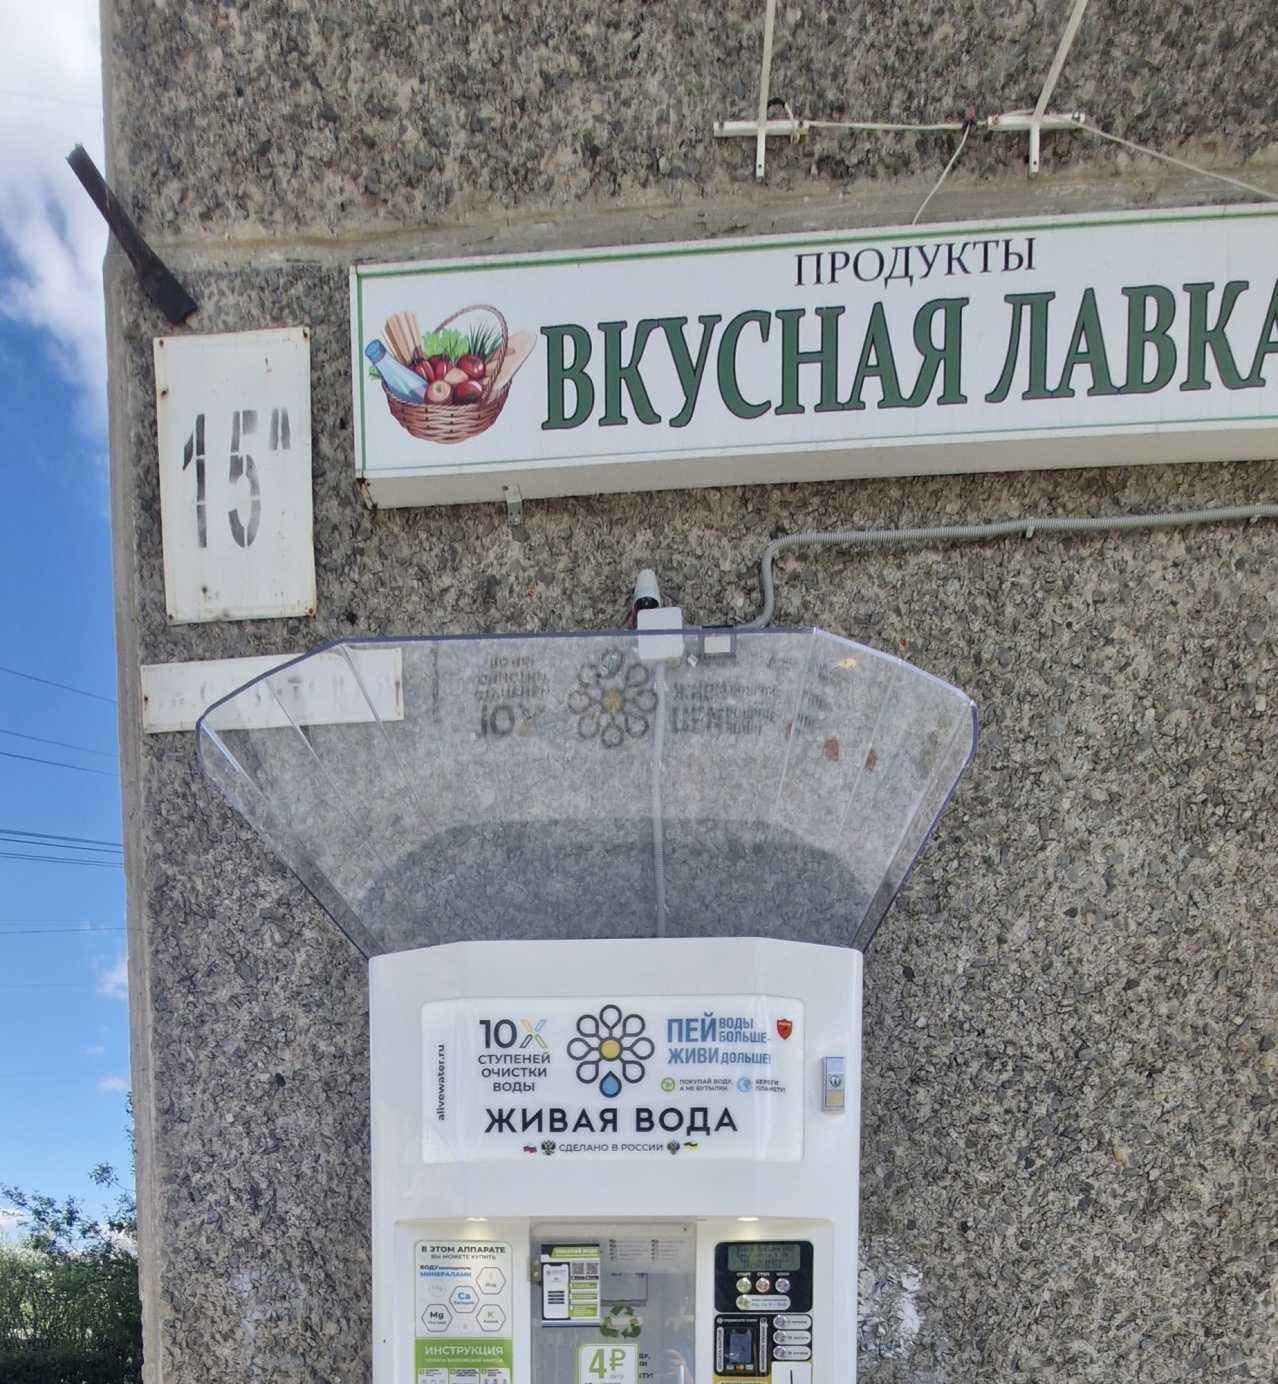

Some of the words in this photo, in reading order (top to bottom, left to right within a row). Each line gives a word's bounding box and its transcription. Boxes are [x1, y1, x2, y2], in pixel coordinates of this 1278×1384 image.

[794, 237, 1036, 289] ПРОДУКТЫ
[540, 297, 970, 431] ВКУСНАЯ
[667, 1012, 717, 1043] ПЕЙ
[718, 1017, 754, 1031] ВОДЫ
[478, 1052, 551, 1065] СТУПЕНЕЙ
[667, 1048, 719, 1064] ЖИВИ
[481, 1067, 548, 1078] ОЧИСТКИ
[436, 1044, 446, 1121] alivewater.ru
[493, 1082, 535, 1093] ВОДЫ
[484, 1108, 618, 1134] ЖИВАЯ
[635, 1107, 738, 1136] ВОДА
[558, 1143, 608, 1153] СДЕЛАНО
[611, 1143, 618, 1152] В
[621, 1143, 663, 1152] РОССИИ
[430, 1311, 444, 1320] Mg
[425, 1346, 504, 1355] ИНСТРУКЦИЯ
